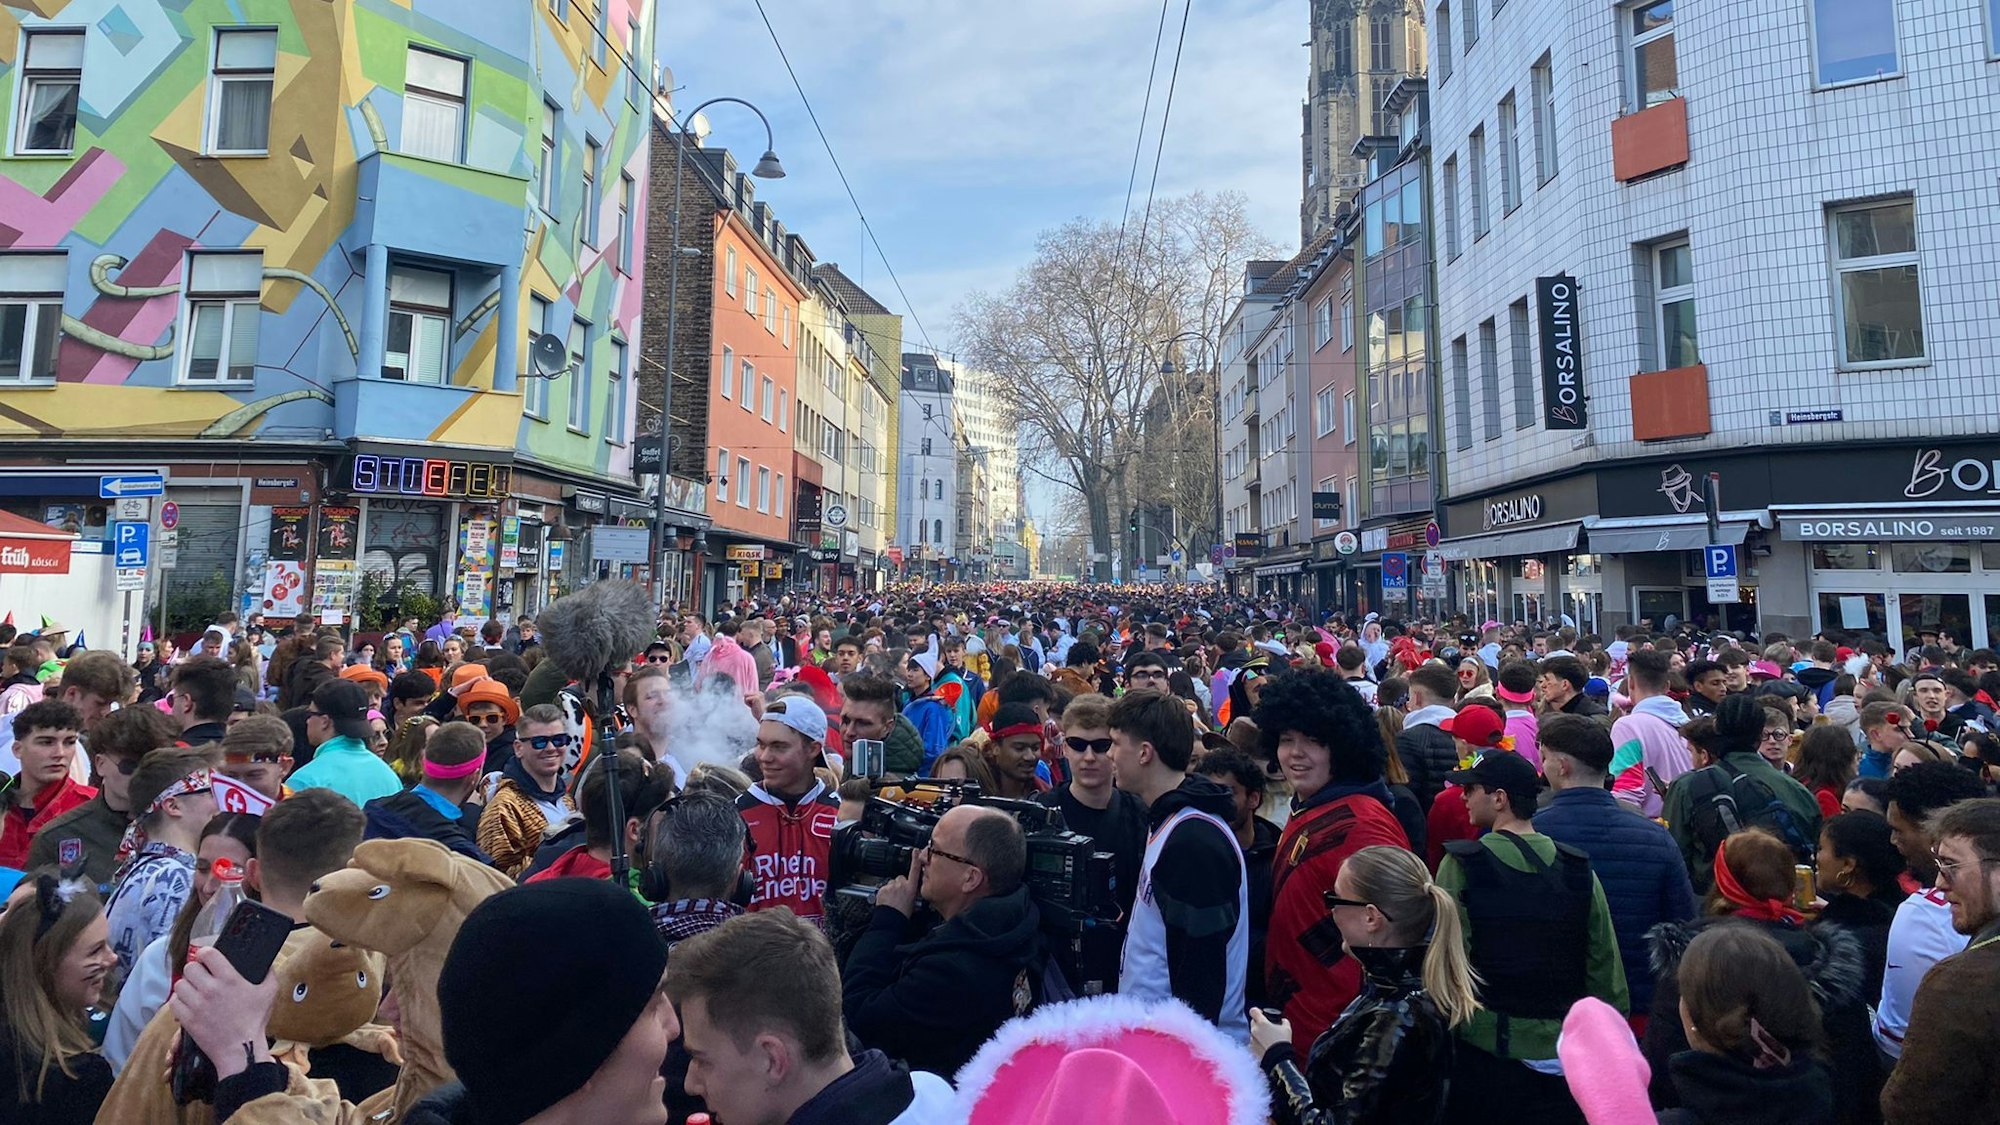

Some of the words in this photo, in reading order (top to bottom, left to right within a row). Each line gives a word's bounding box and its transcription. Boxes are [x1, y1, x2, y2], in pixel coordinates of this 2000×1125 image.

[1551, 283, 1578, 425] BORSALINO
[1483, 494, 1540, 531] BORSALINO
[121, 526, 136, 544] P
[1800, 521, 1934, 536] BORSALINO
[1940, 526, 1962, 536] seit
[1966, 526, 1994, 536] 1987
[737, 551, 761, 559] KIOSK
[825, 550, 839, 560] sky
[1712, 549, 1728, 574] P
[754, 849, 816, 878] Rhein
[750, 876, 828, 904] Energie
